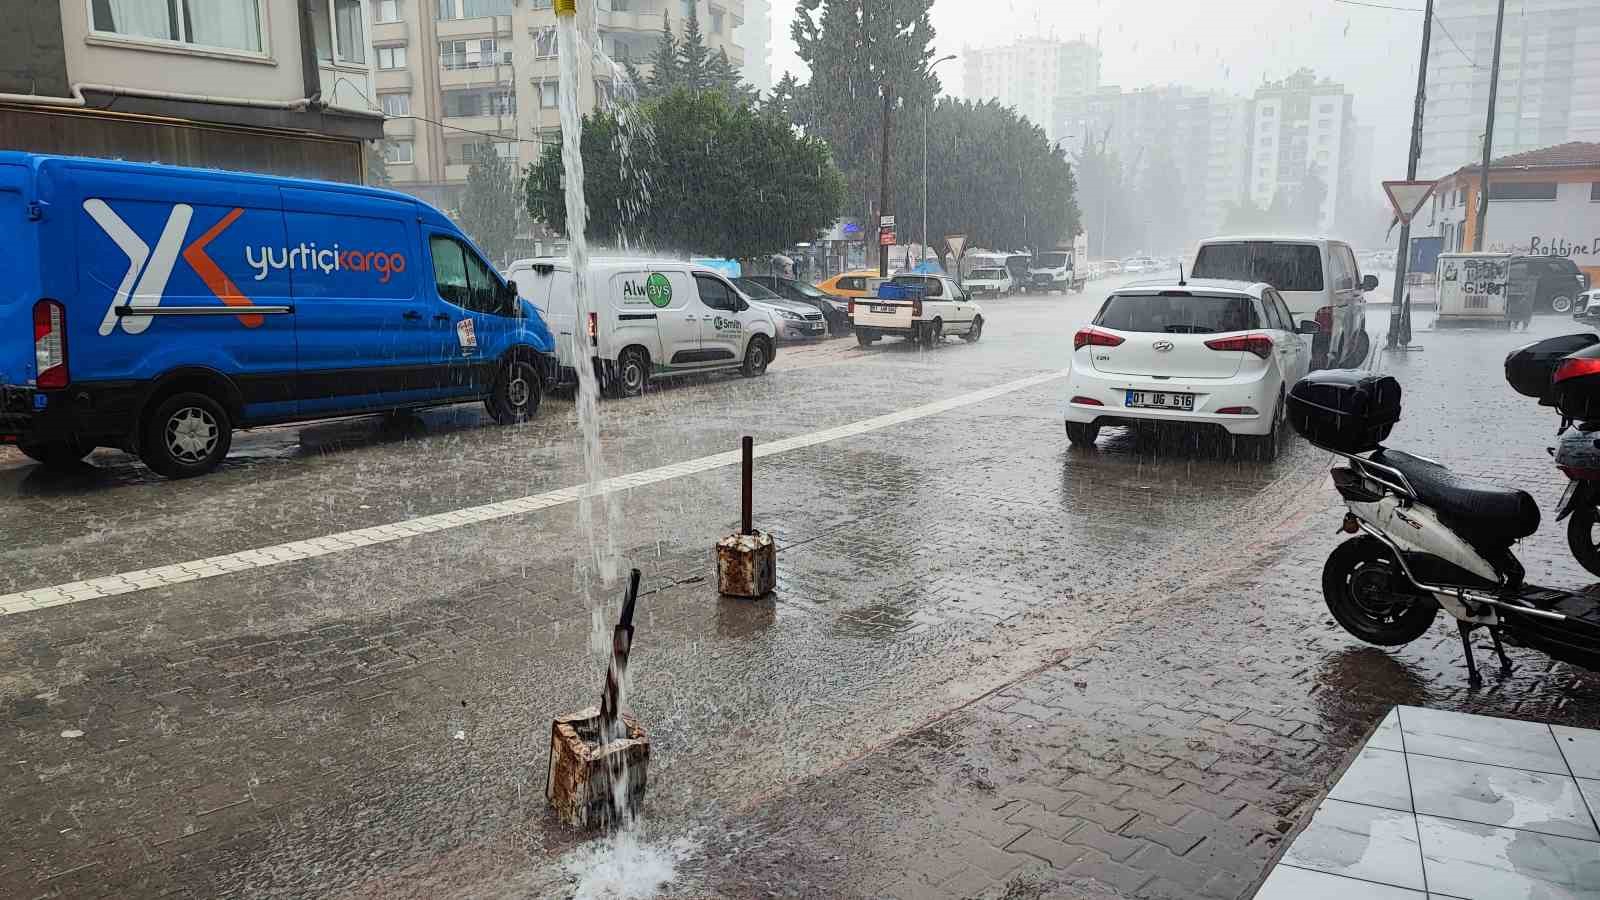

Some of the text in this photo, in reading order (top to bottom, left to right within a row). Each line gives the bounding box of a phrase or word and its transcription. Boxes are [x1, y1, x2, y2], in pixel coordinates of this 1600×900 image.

[623, 279, 670, 298] Always
[1133, 392, 1145, 404] 01
[1173, 394, 1192, 406] 616
